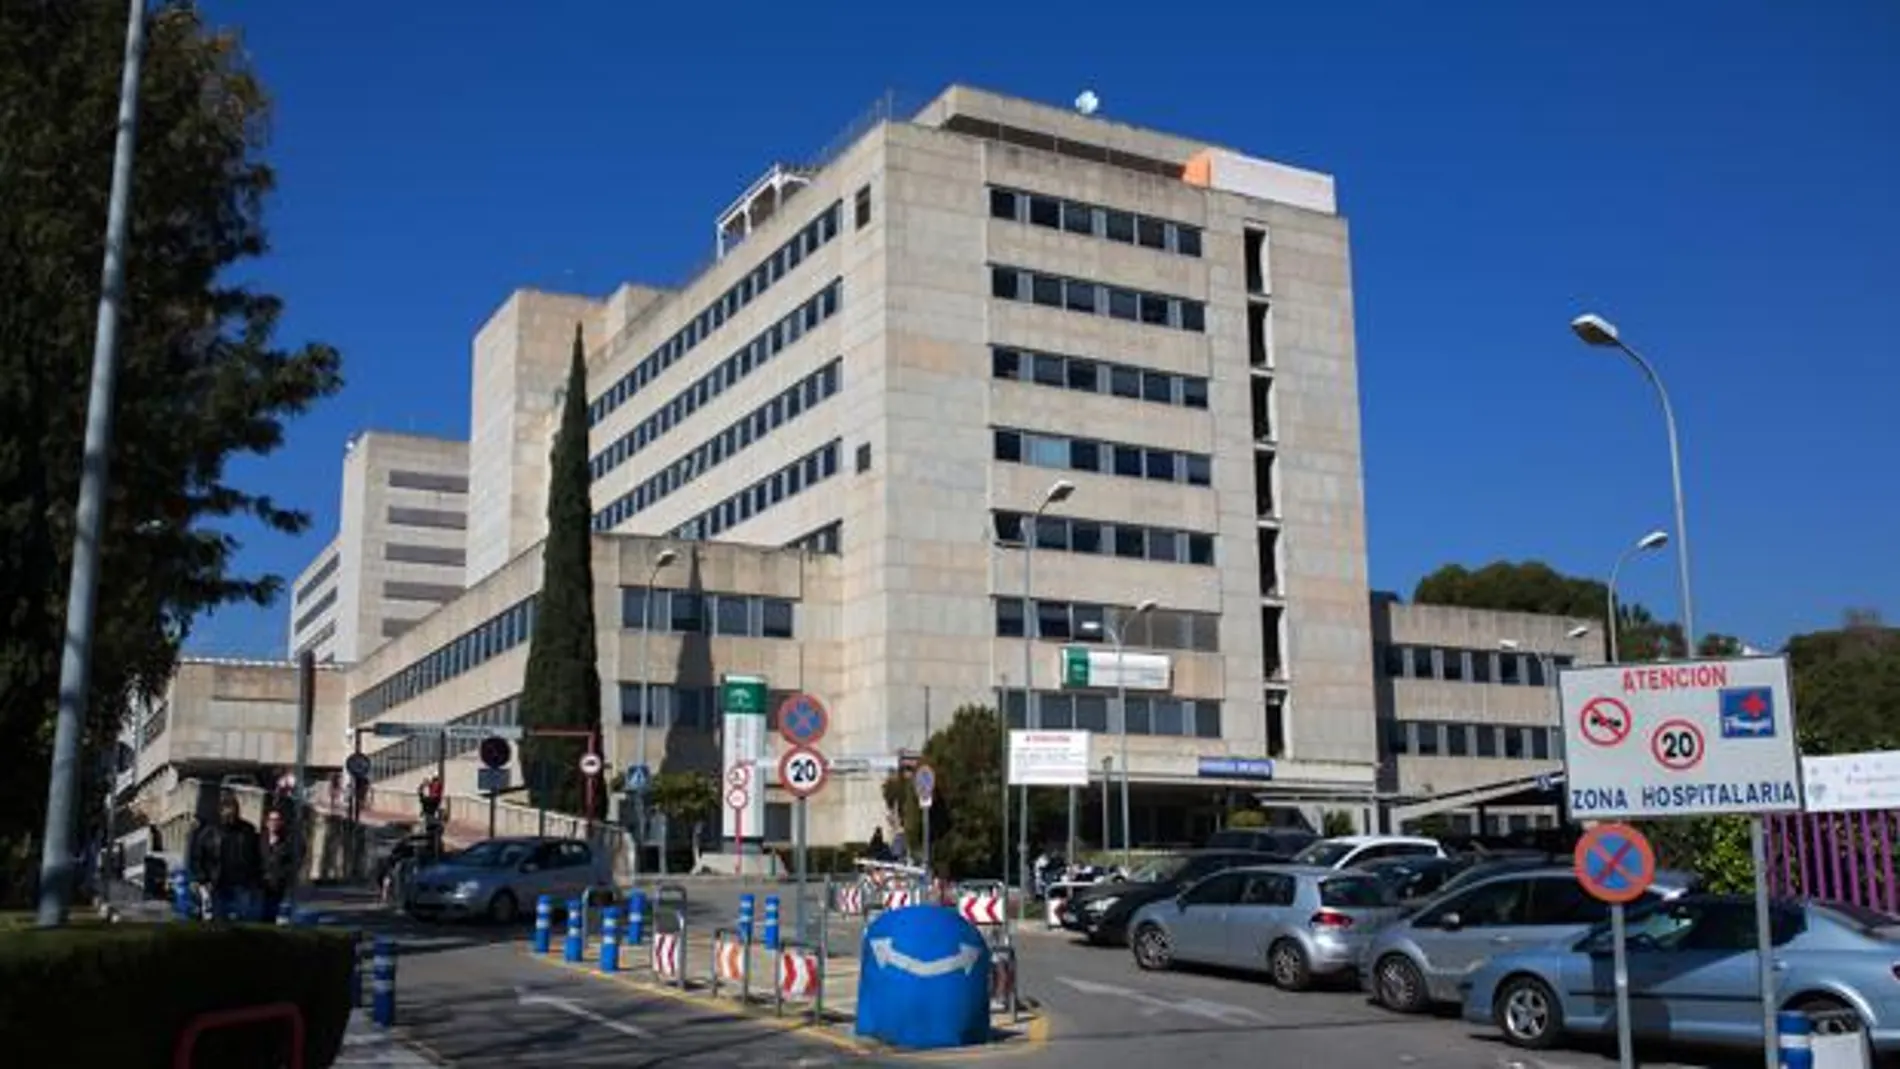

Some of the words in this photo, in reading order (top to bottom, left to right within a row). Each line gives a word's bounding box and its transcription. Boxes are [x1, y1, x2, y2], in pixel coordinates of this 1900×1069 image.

[1662, 731, 1695, 758] 20
[791, 758, 817, 782] 20
[1572, 789, 1628, 809] ZONA
[1642, 781, 1796, 806] HOSPITALARIA
